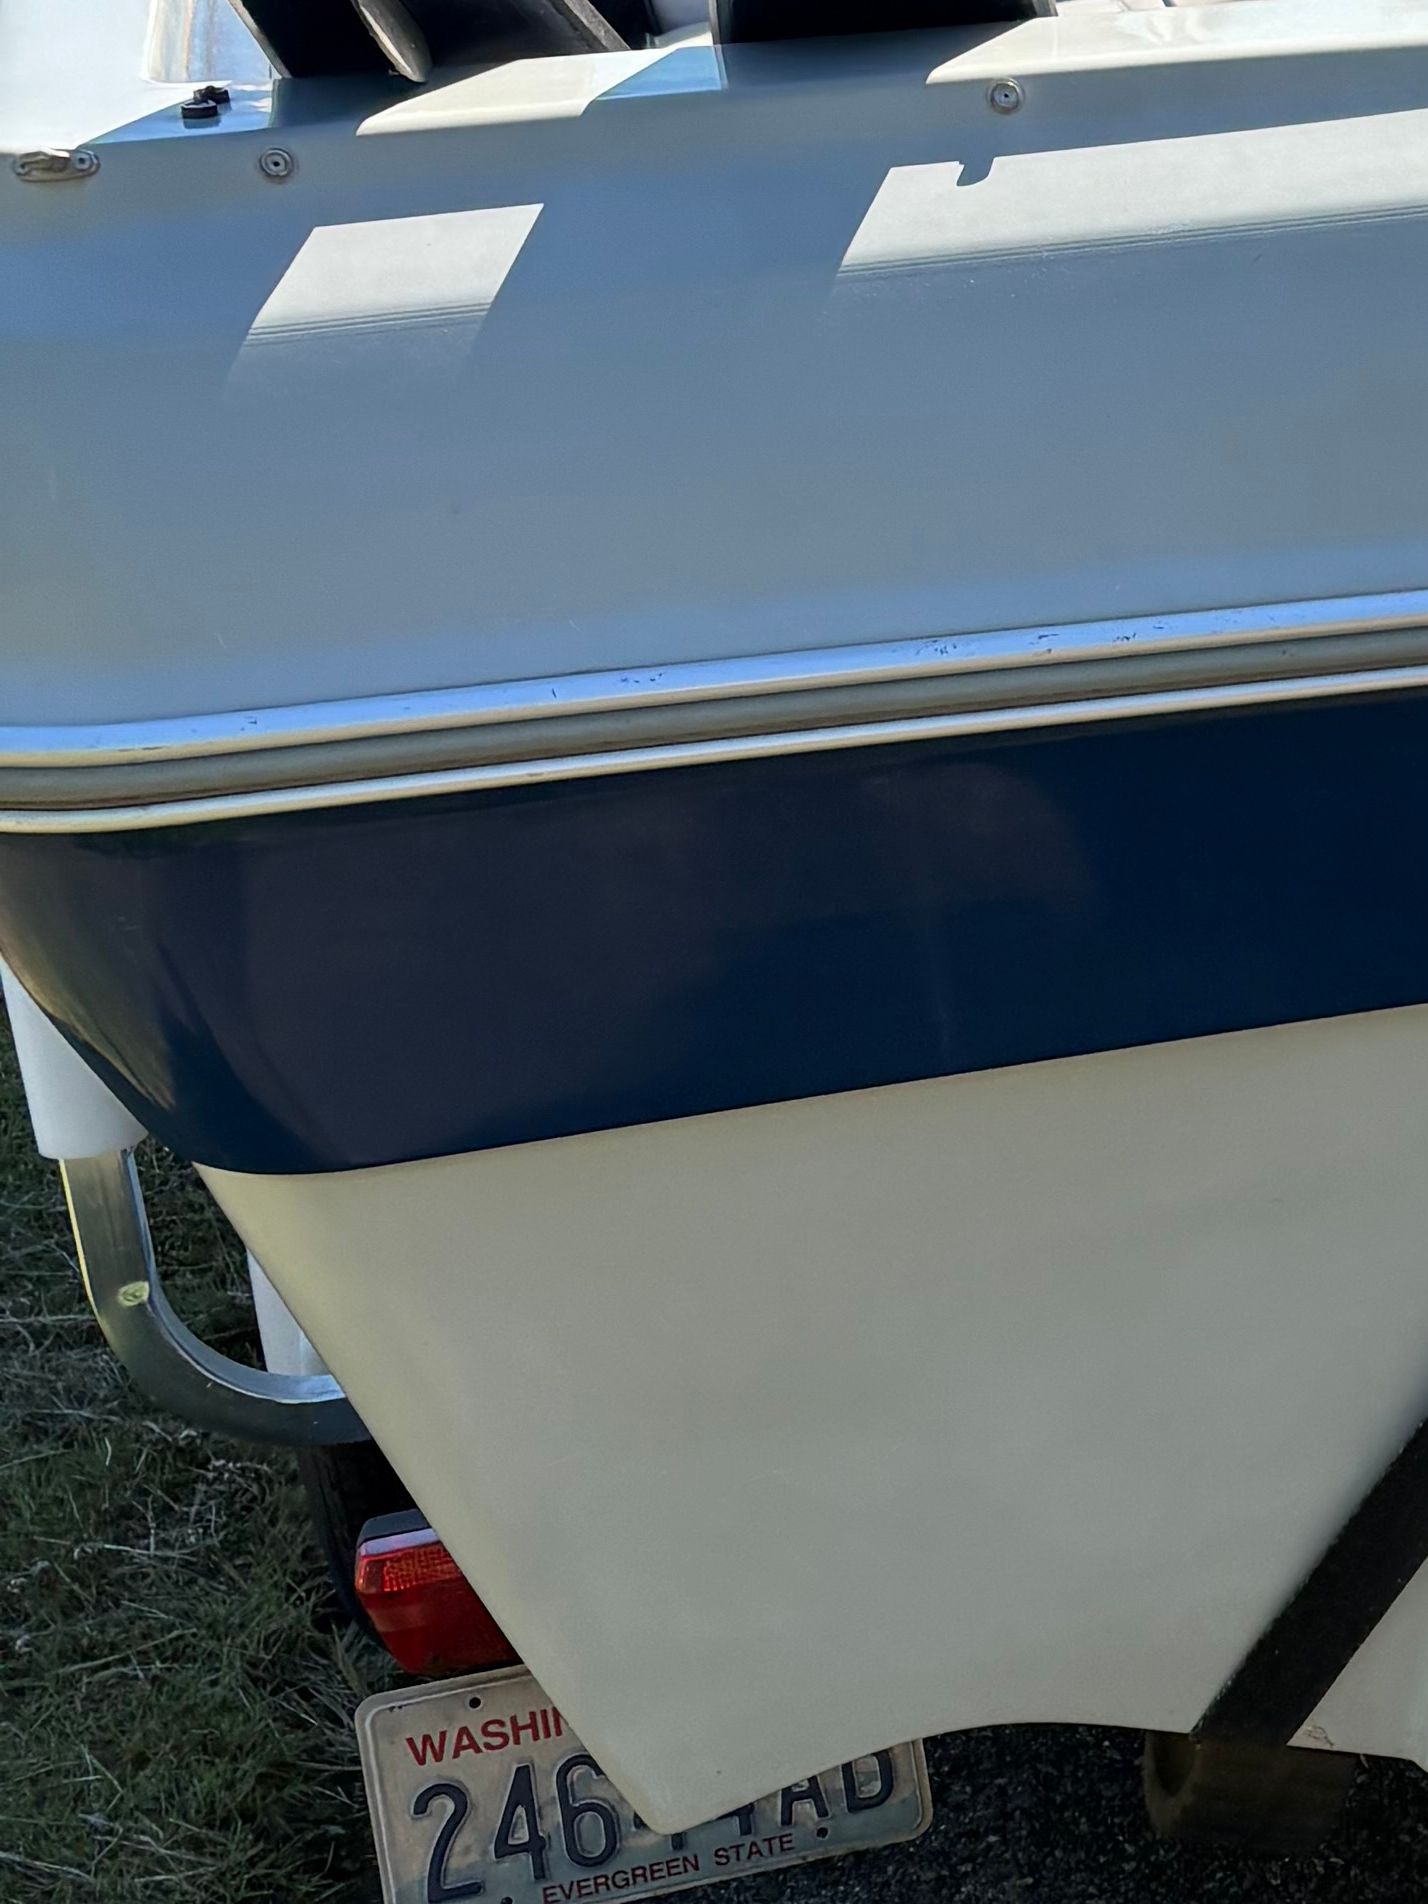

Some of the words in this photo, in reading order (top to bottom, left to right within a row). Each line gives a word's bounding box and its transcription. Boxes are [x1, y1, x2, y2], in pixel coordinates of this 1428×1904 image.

[406, 1706, 563, 1766] WASHI
[541, 1853, 701, 1904] EVERGREEN
[714, 1833, 795, 1866] STATE
